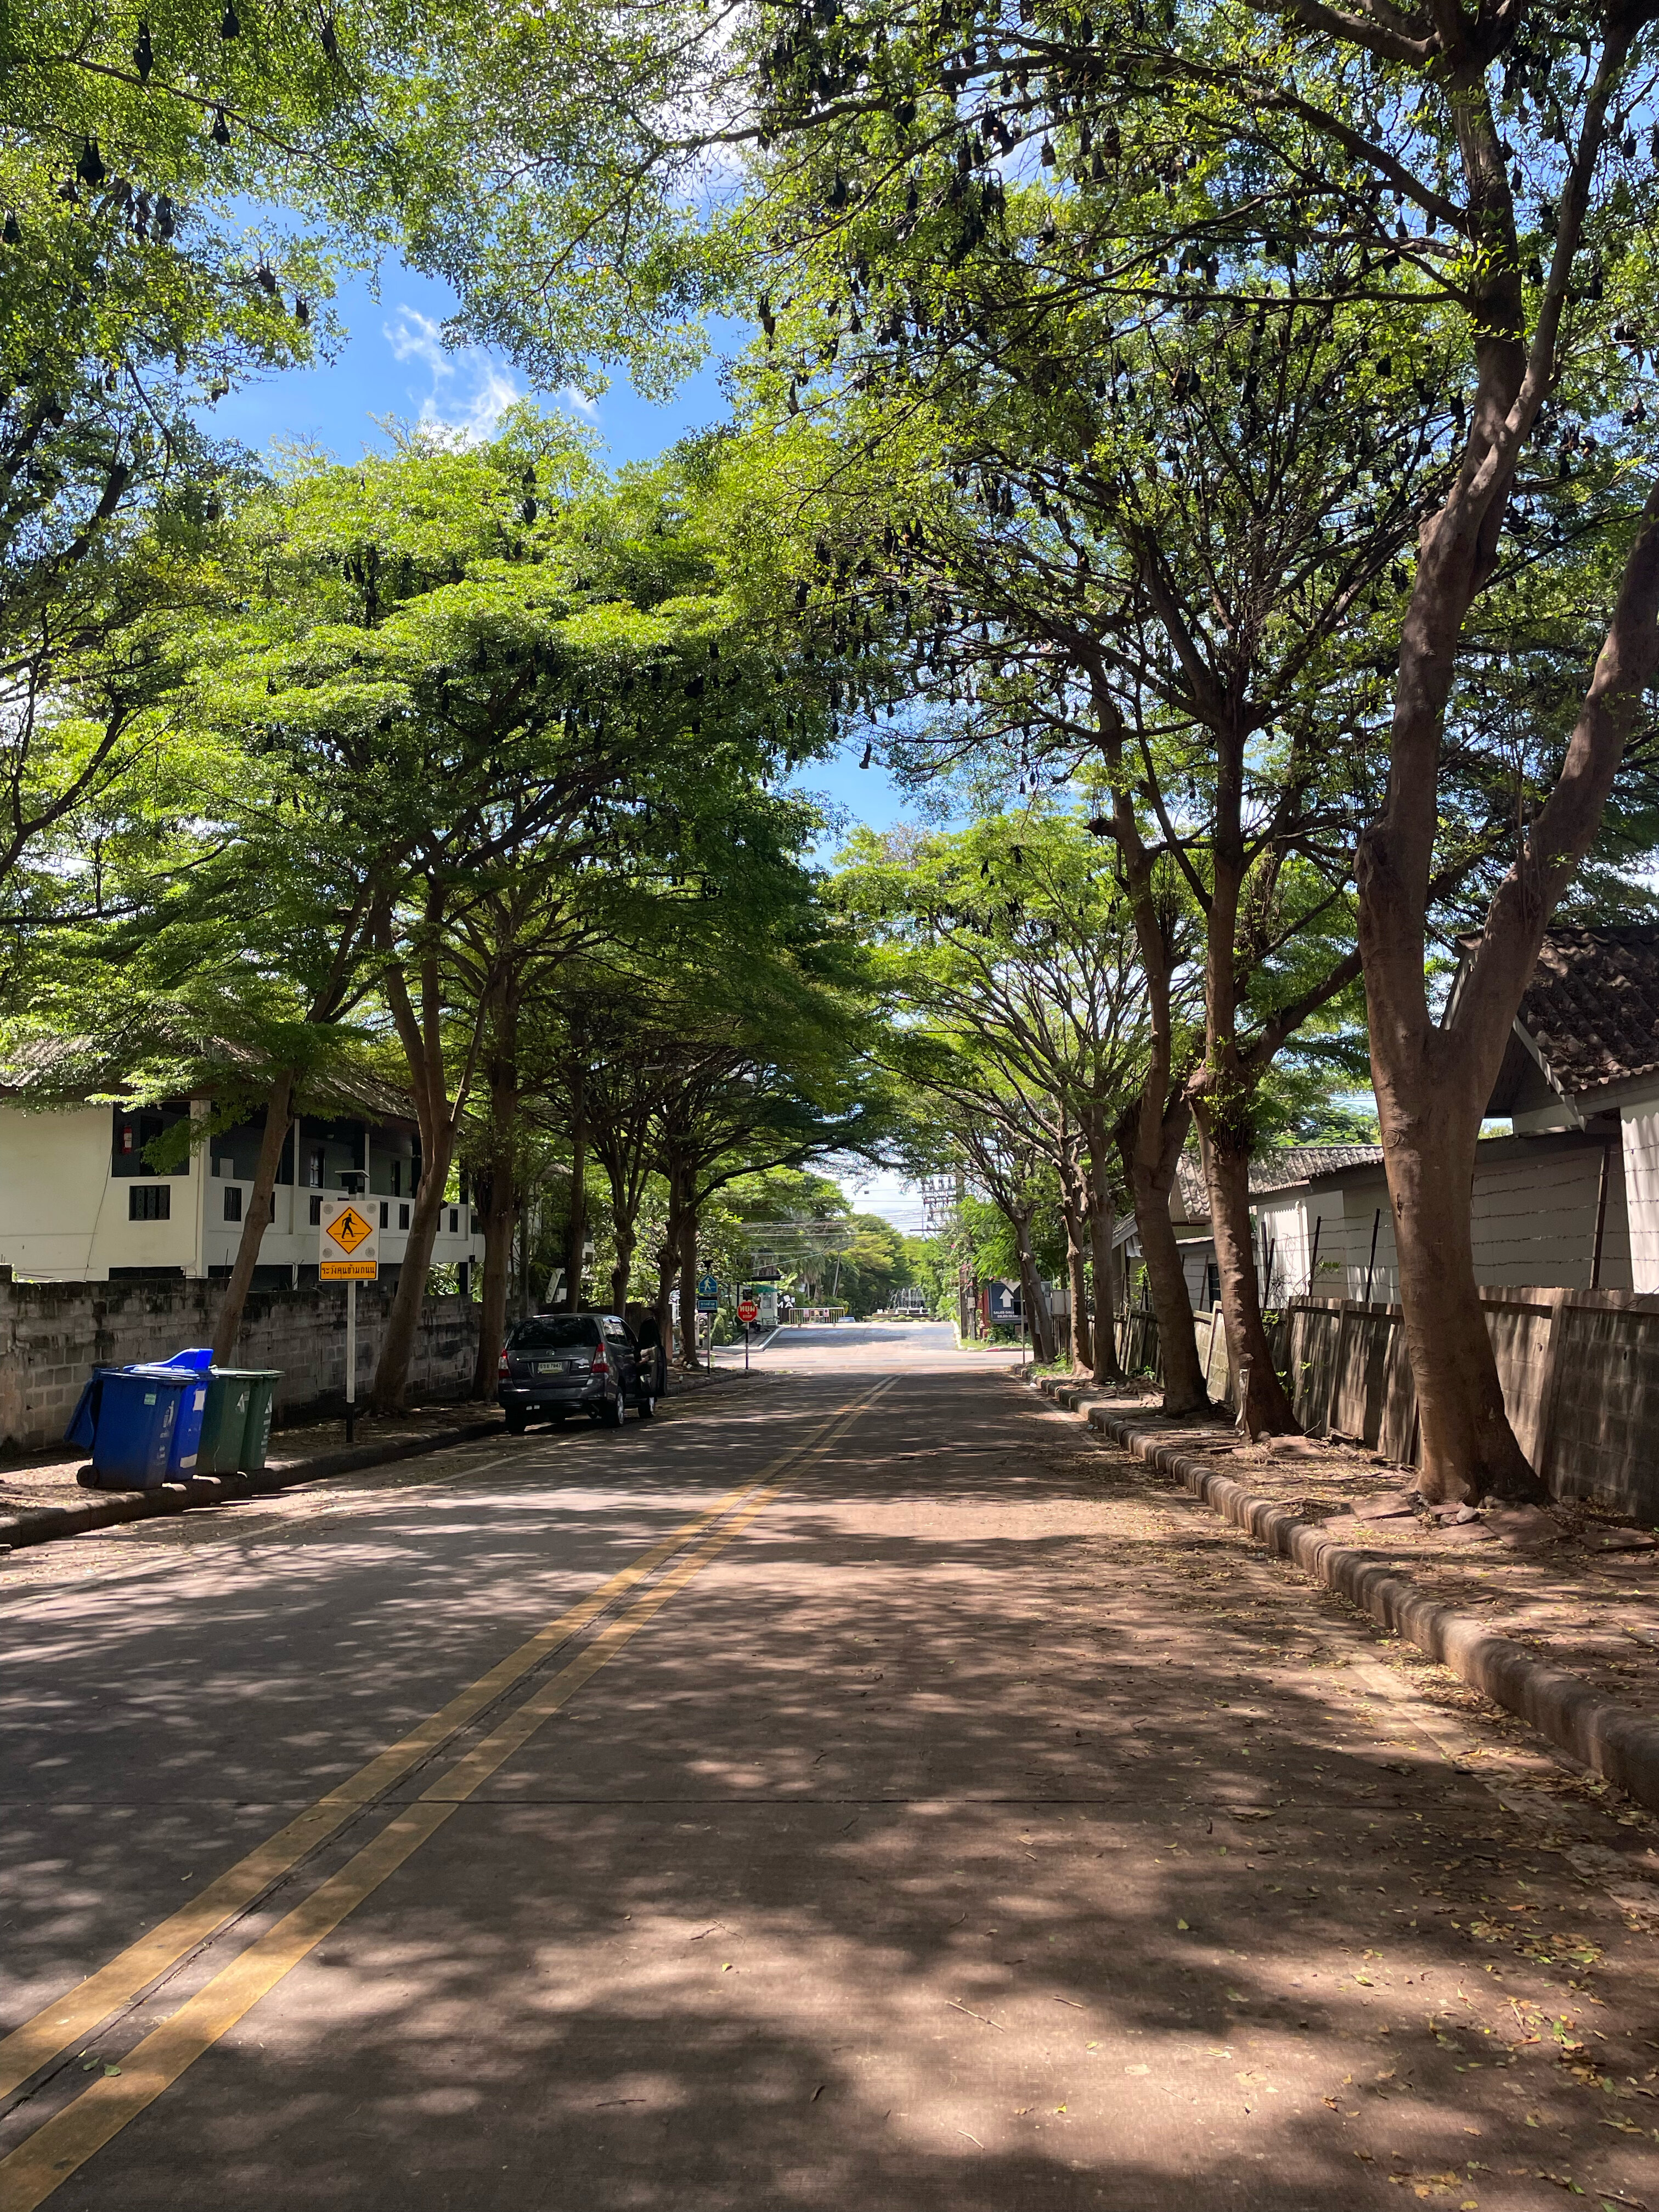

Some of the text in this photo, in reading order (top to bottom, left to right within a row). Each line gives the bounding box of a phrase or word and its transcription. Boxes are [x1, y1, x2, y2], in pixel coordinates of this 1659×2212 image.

[321, 1264, 375, 1274] ระวังคนข้ามถนน
[740, 1306, 755, 1314] หยุด
